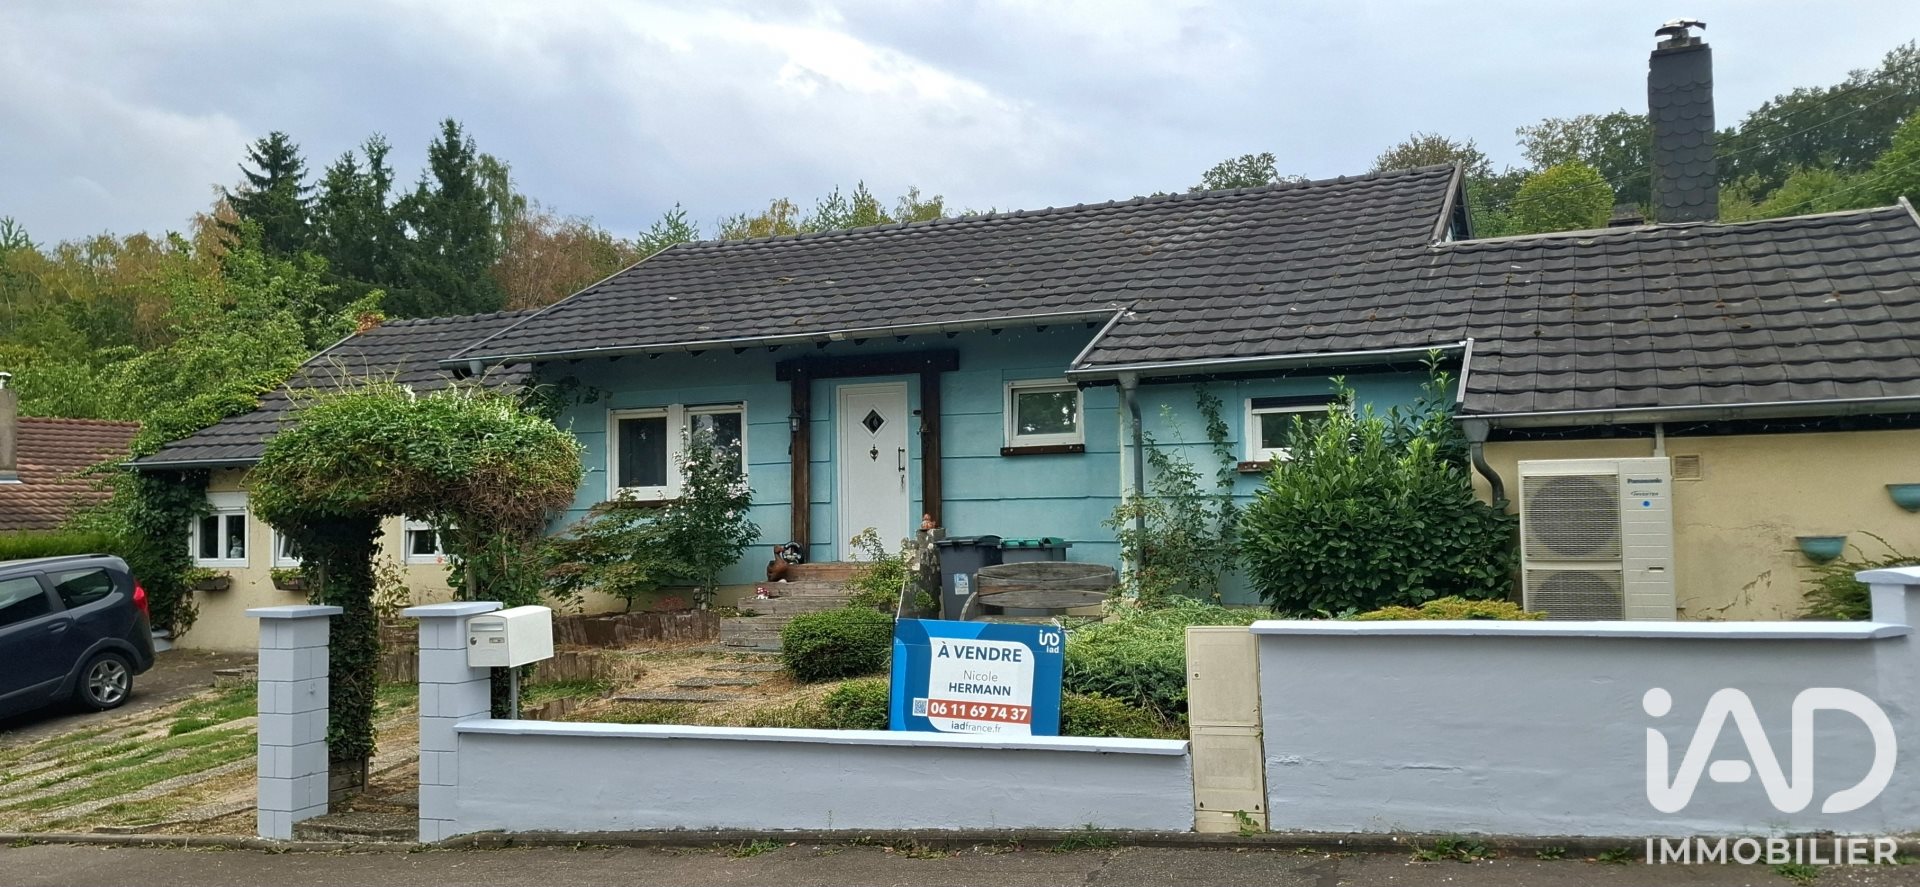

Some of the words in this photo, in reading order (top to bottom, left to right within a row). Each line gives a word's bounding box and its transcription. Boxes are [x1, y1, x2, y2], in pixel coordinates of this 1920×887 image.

[938, 641, 950, 659] À
[954, 645, 1022, 663] VENDRE
[1046, 646, 1060, 654] iad
[963, 670, 998, 682] Nicole
[948, 682, 1011, 696] HERMANN
[930, 702, 947, 715] 06
[951, 703, 966, 716] 11
[970, 704, 988, 718] 69
[991, 706, 1007, 720] 74
[1010, 707, 1028, 721] 37
[951, 720, 1002, 733] iadfrance.fr
